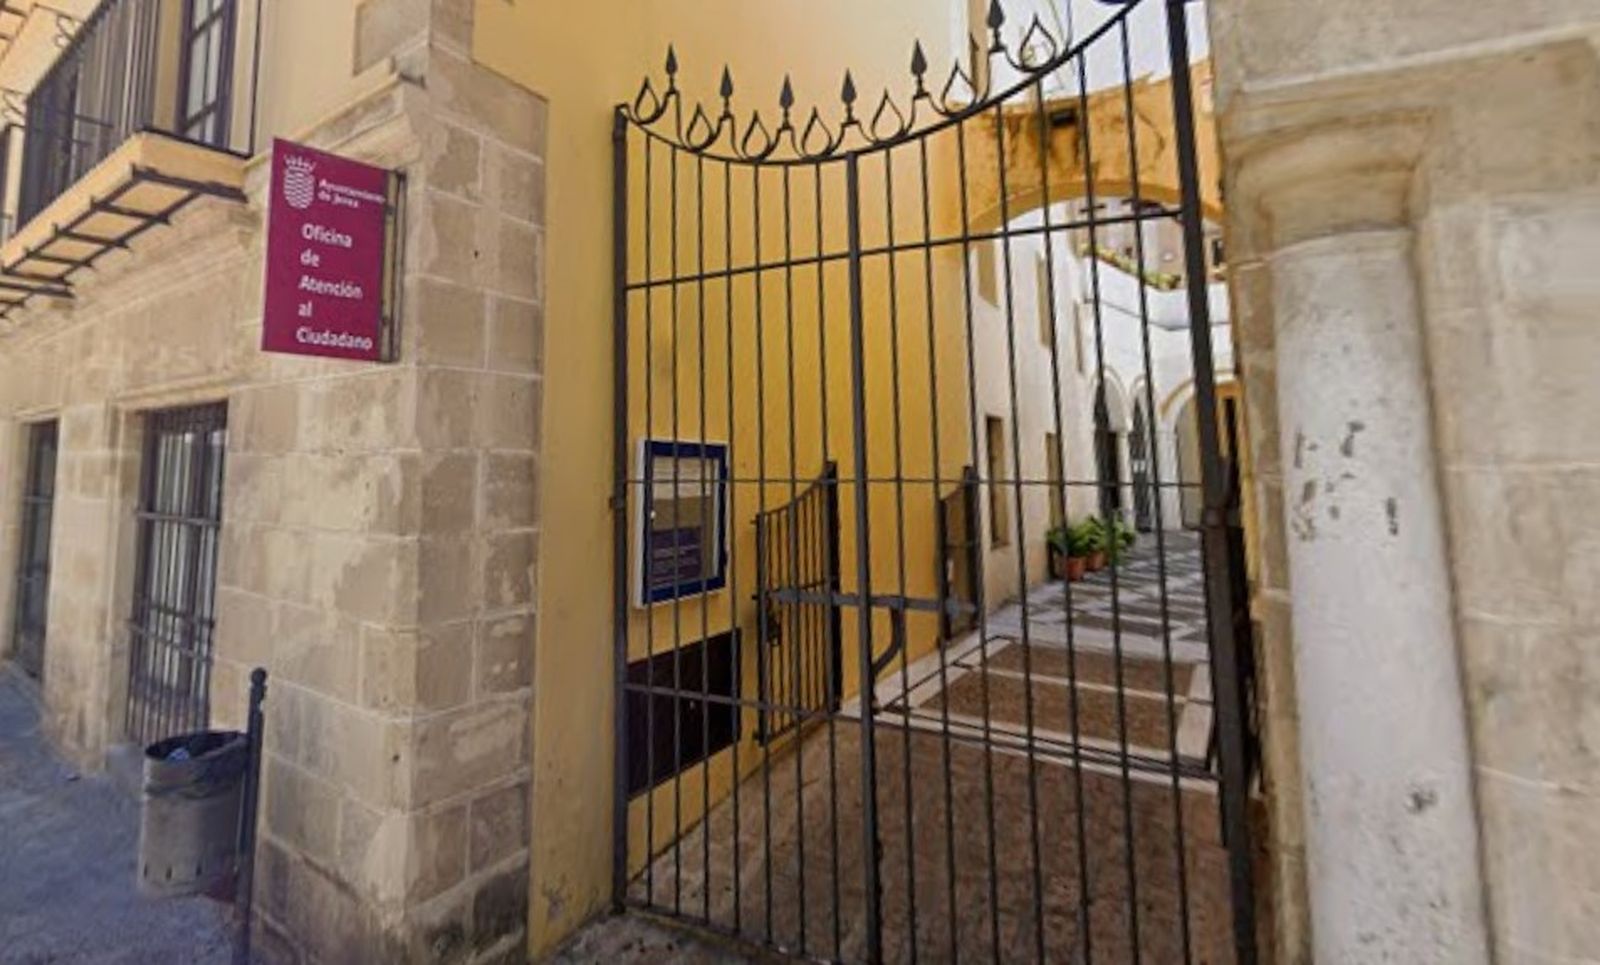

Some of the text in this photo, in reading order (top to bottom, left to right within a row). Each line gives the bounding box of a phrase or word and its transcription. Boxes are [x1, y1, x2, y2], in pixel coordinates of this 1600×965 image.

[302, 223, 352, 248] Oficina
[300, 248, 320, 267] de
[299, 274, 363, 299] Atención
[298, 301, 312, 317] al
[296, 326, 372, 350] Ciudadano
